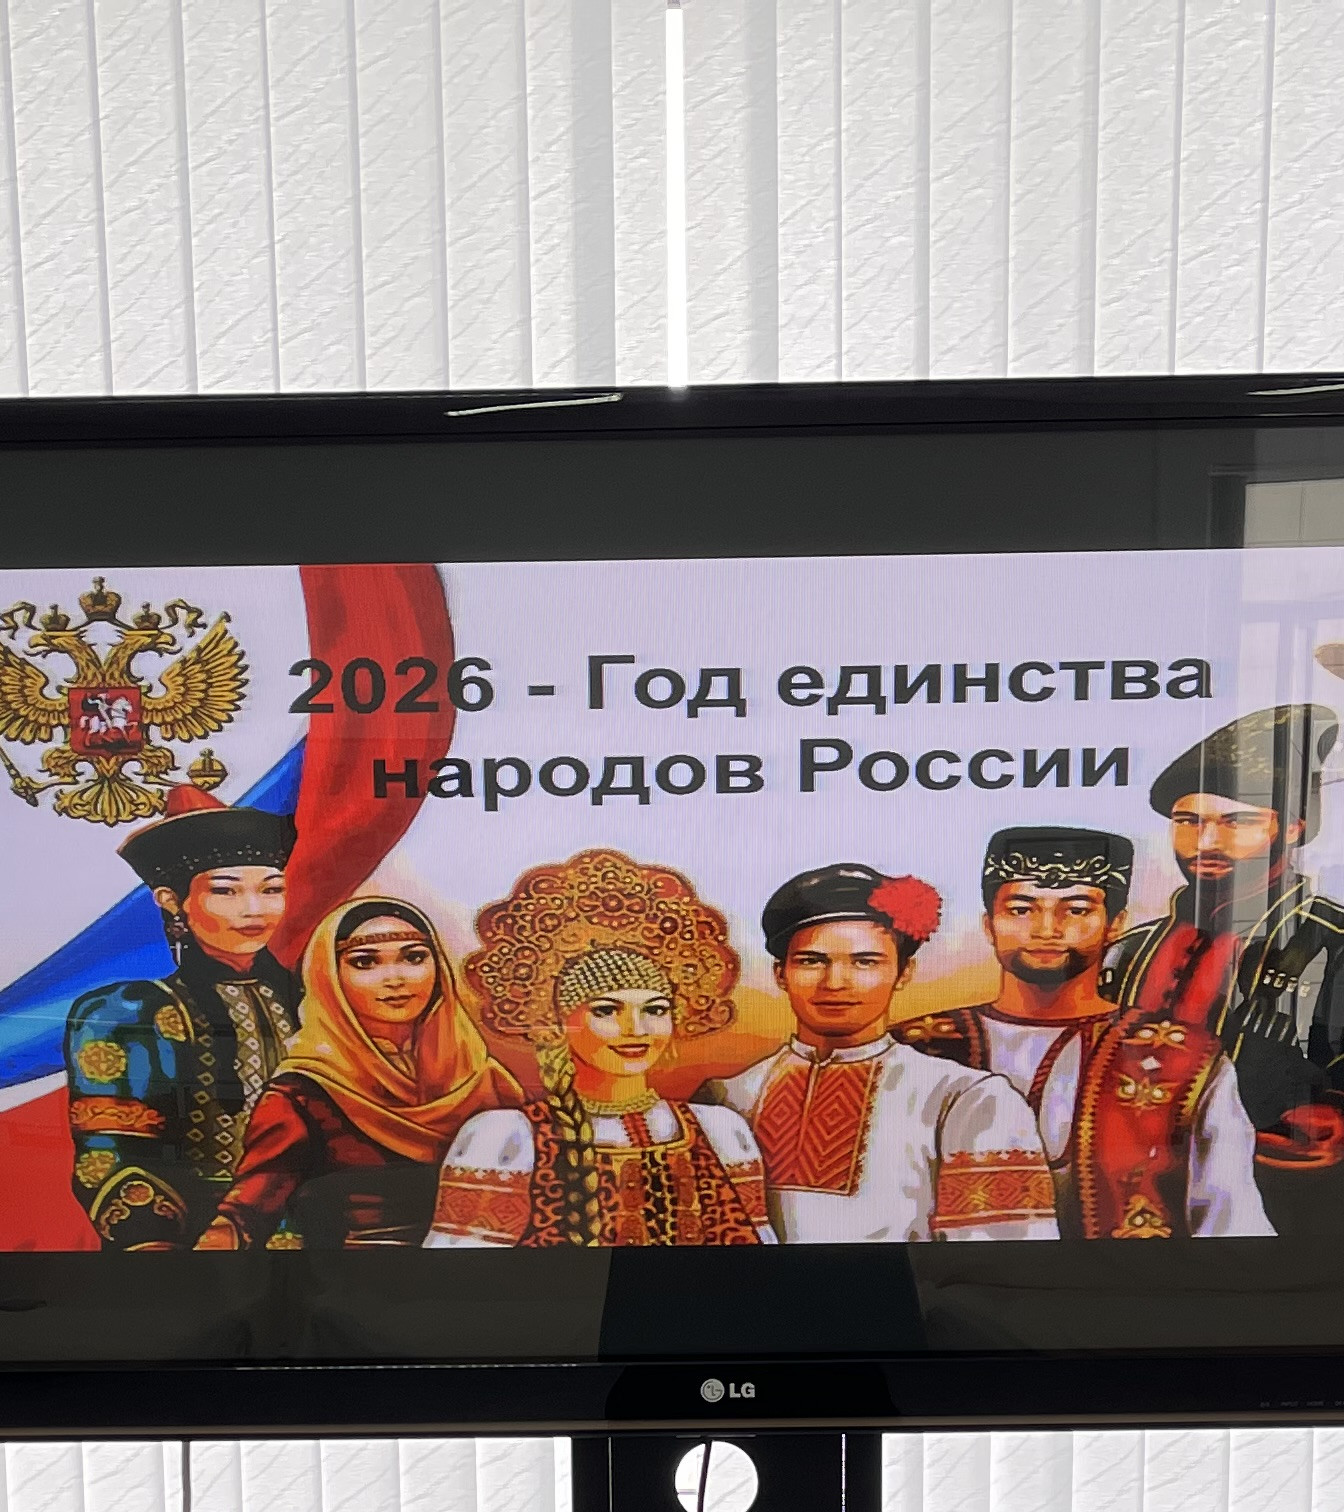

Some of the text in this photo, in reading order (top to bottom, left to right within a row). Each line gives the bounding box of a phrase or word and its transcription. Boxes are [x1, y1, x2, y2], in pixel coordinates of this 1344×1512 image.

[288, 656, 494, 714] 2026
[588, 655, 747, 718] Год
[777, 657, 1213, 716] единства
[373, 737, 1130, 811] народов России
[729, 1382, 756, 1399] LG
